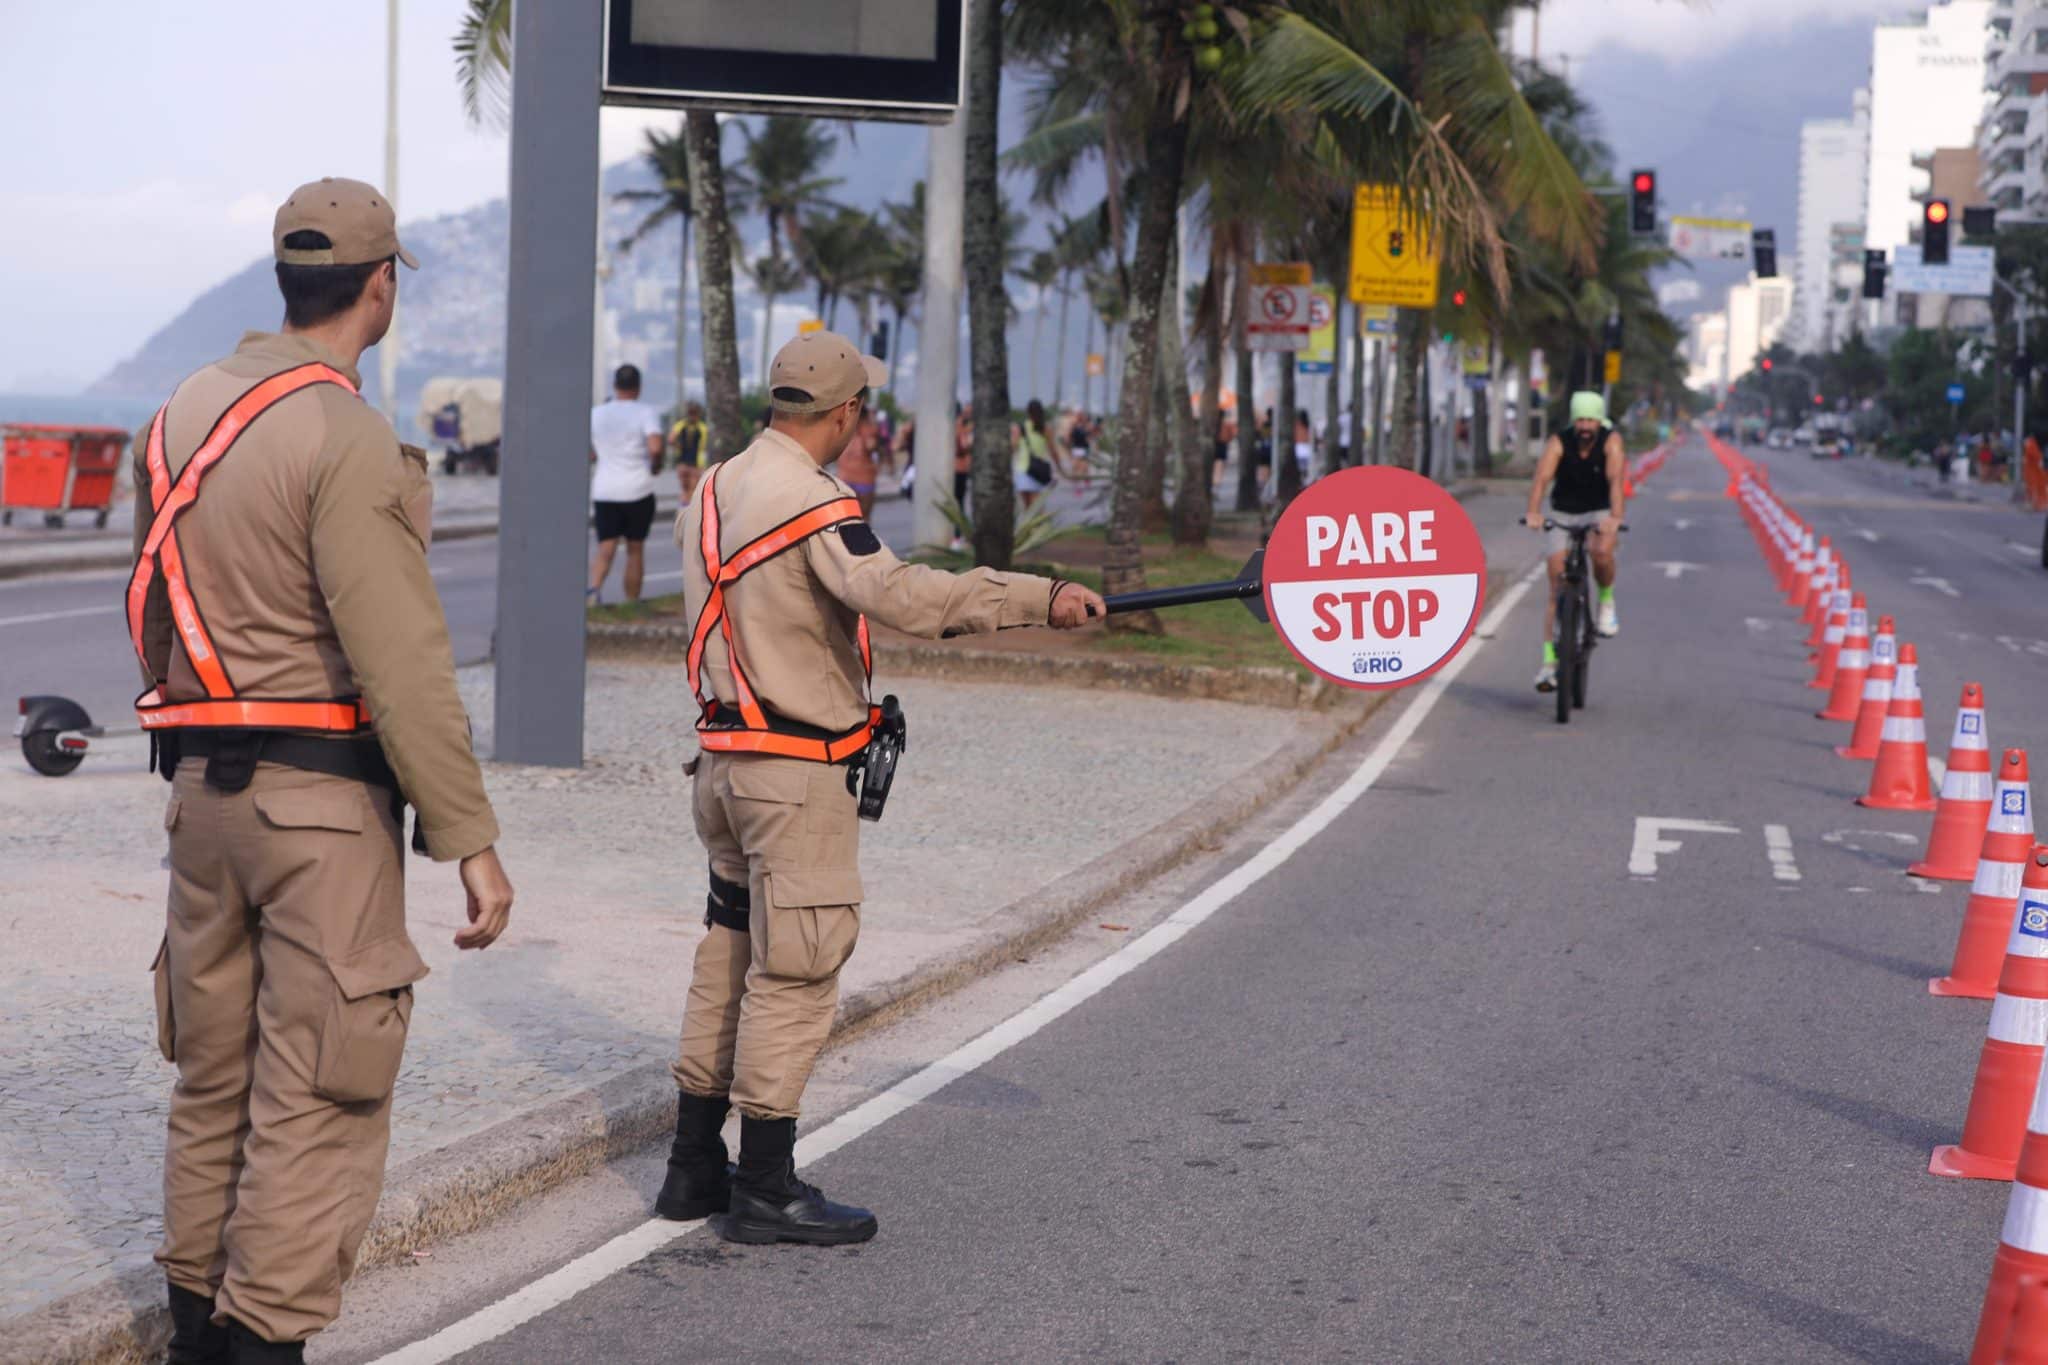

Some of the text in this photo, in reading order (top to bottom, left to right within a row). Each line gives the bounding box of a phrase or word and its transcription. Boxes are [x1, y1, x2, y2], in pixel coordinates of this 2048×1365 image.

[1306, 510, 1437, 567] PARE
[1312, 589, 1439, 641] STOP
[1369, 657, 1403, 673] RIO
